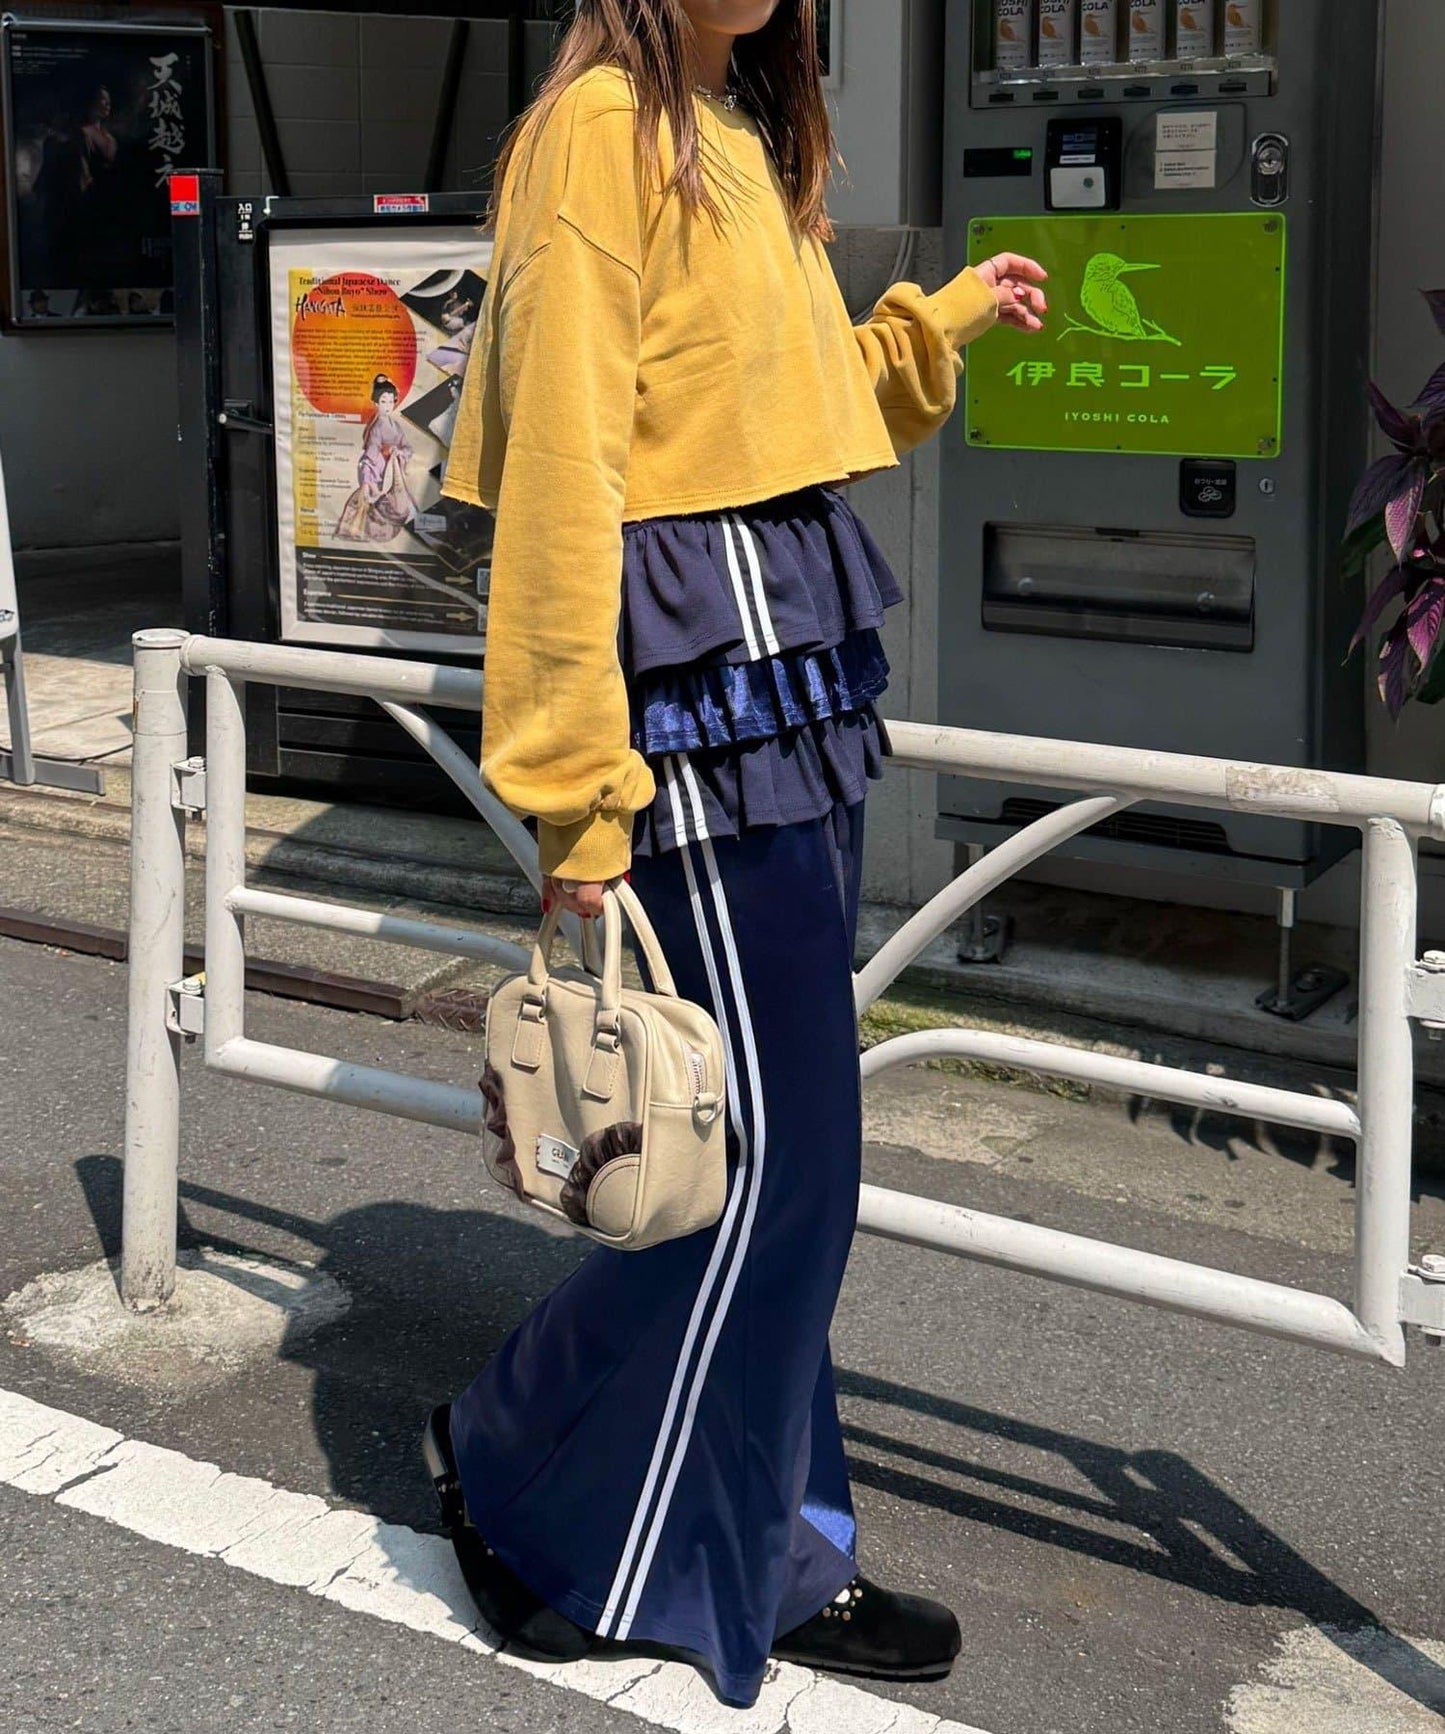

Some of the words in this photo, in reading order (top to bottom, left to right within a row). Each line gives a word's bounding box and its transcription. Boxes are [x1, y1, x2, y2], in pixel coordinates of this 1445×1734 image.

[998, 7, 1024, 16] COLA
[1041, 4, 1066, 14] COLA
[1082, 2, 1109, 11] COLA
[299, 276, 341, 286] Traditional
[342, 277, 375, 288] Japanese
[376, 278, 400, 287] Dance
[1006, 362, 1237, 390] 伊良コーラ
[1064, 412, 1120, 423] IYOSHI
[1126, 413, 1169, 424] COLA
